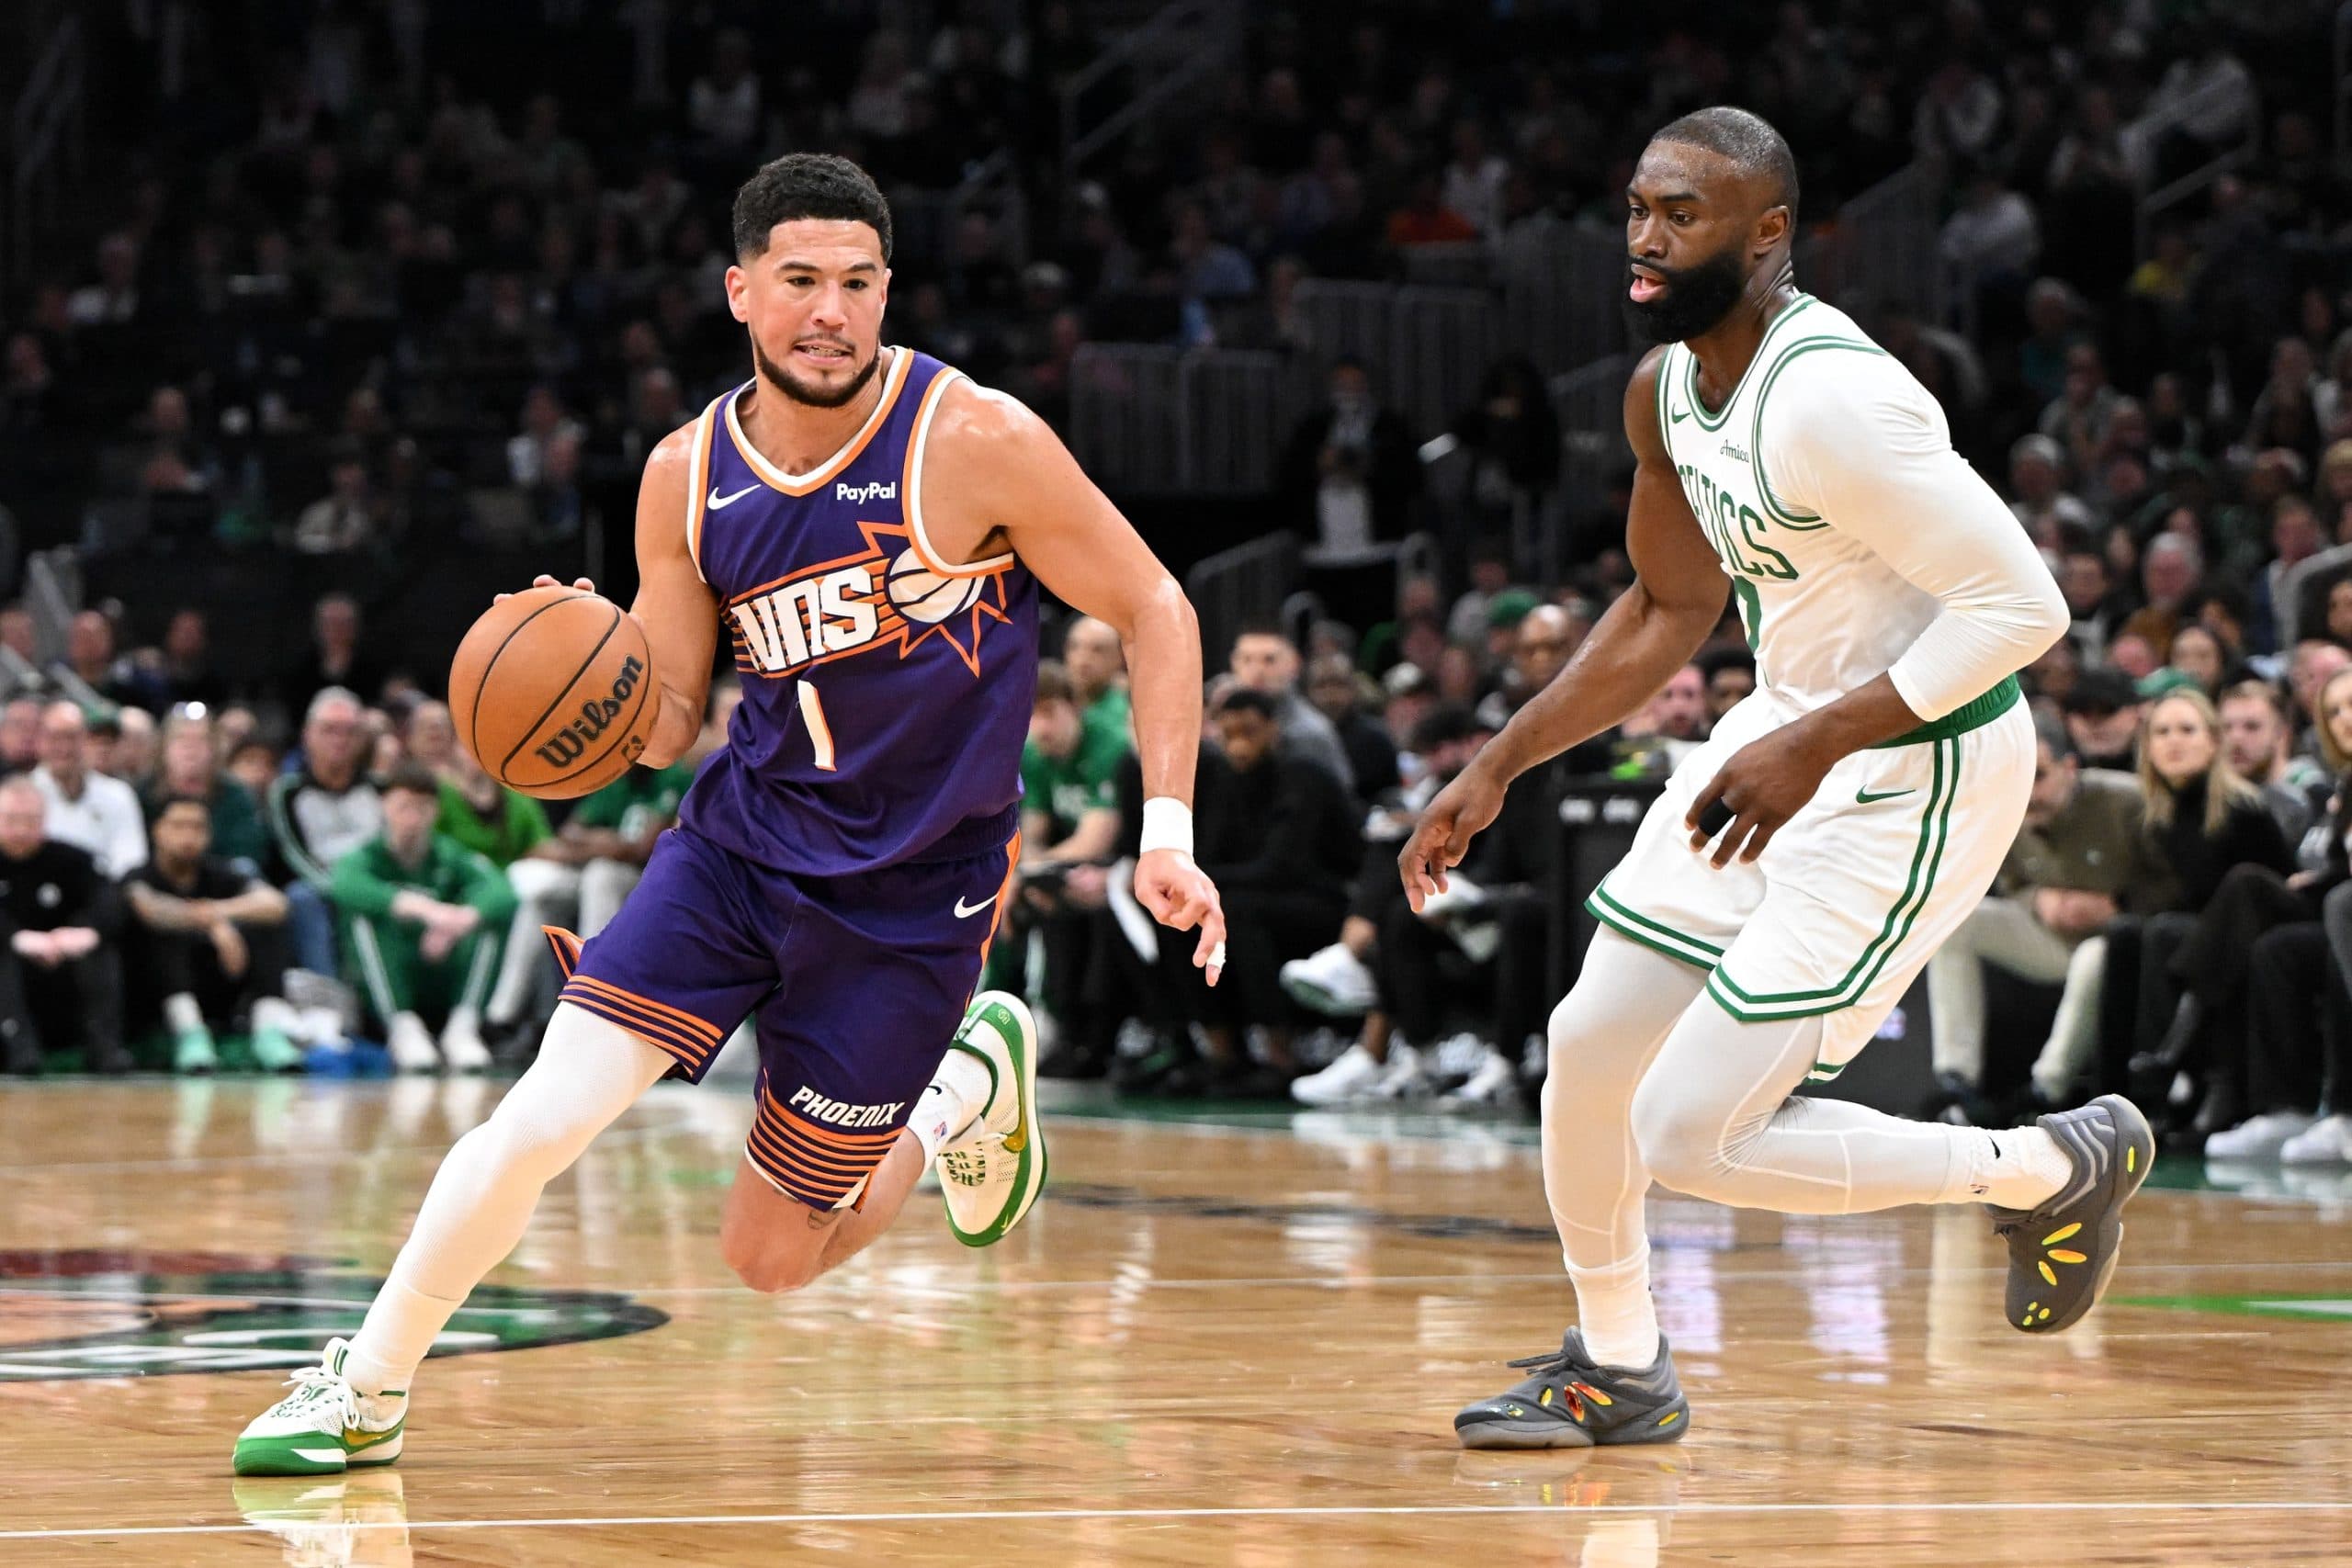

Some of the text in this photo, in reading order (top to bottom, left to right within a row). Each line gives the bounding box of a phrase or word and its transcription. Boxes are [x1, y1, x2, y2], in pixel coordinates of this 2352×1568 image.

[1720, 439, 1749, 463] Amica
[836, 482, 896, 504] PayPal
[730, 565, 879, 671] UNS
[535, 654, 643, 768] Wilson
[797, 680, 837, 772] 1
[789, 1085, 906, 1128] PHOENIX
